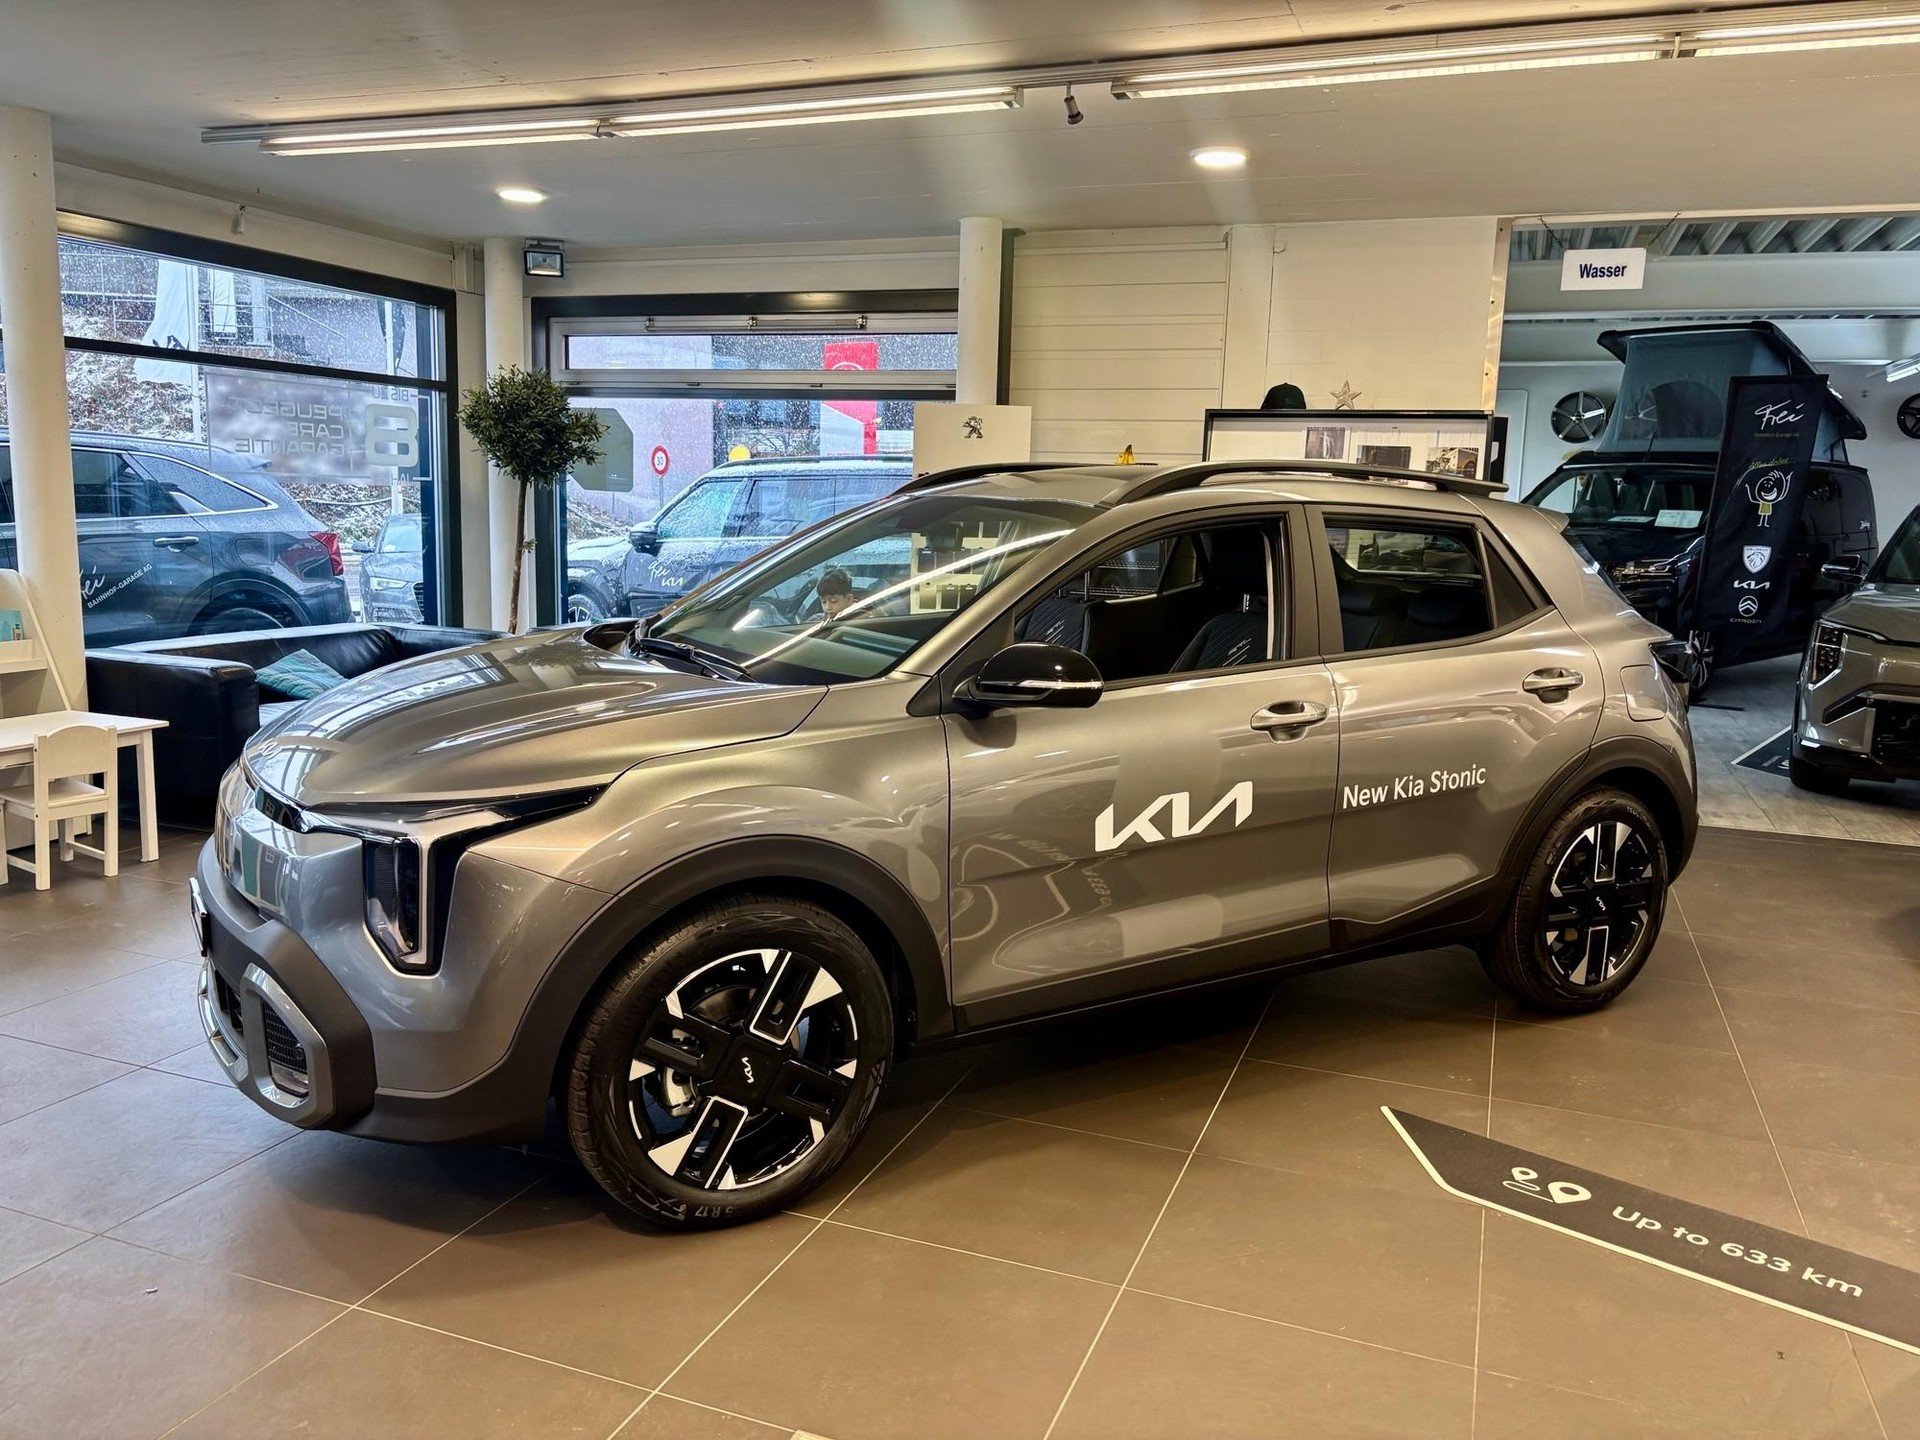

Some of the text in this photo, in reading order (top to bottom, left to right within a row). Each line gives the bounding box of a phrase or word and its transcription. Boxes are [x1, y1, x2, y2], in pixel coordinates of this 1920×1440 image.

[1579, 263, 1627, 278] Wasser
[1754, 399, 1805, 430] Frei
[87, 563, 153, 609] BAHNHOF-GARAGE AG
[1343, 764, 1487, 809] New Kia Stonic
[1095, 781, 1253, 852] KIA
[1612, 1206, 1864, 1298] Up to 633 km
